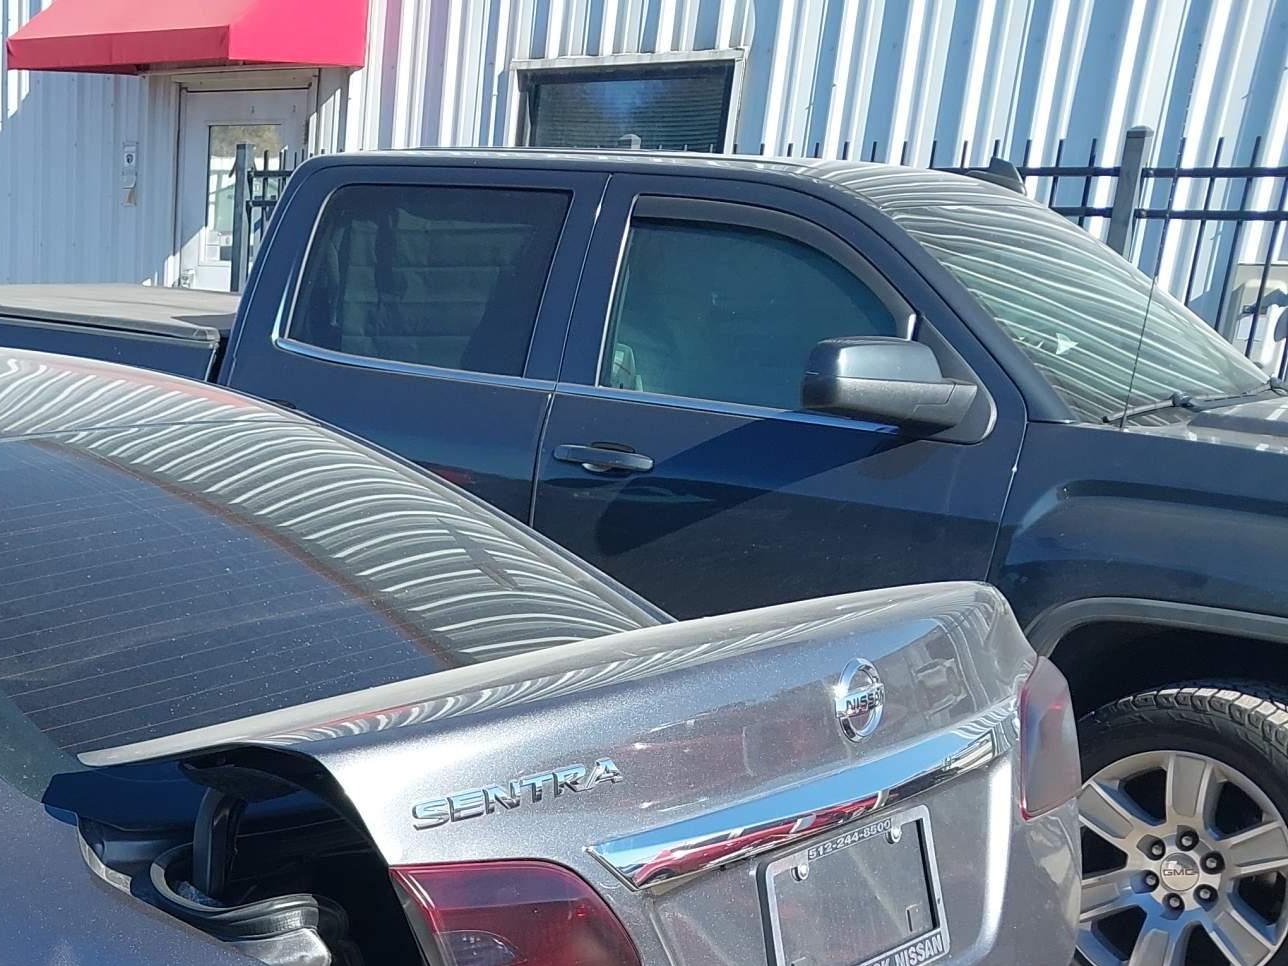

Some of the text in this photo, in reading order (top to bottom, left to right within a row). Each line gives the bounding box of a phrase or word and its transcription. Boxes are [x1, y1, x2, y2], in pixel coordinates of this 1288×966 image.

[412, 757, 623, 830] SENTRA
[808, 819, 892, 859] 512-244-8500
[1163, 868, 1198, 876] GMC
